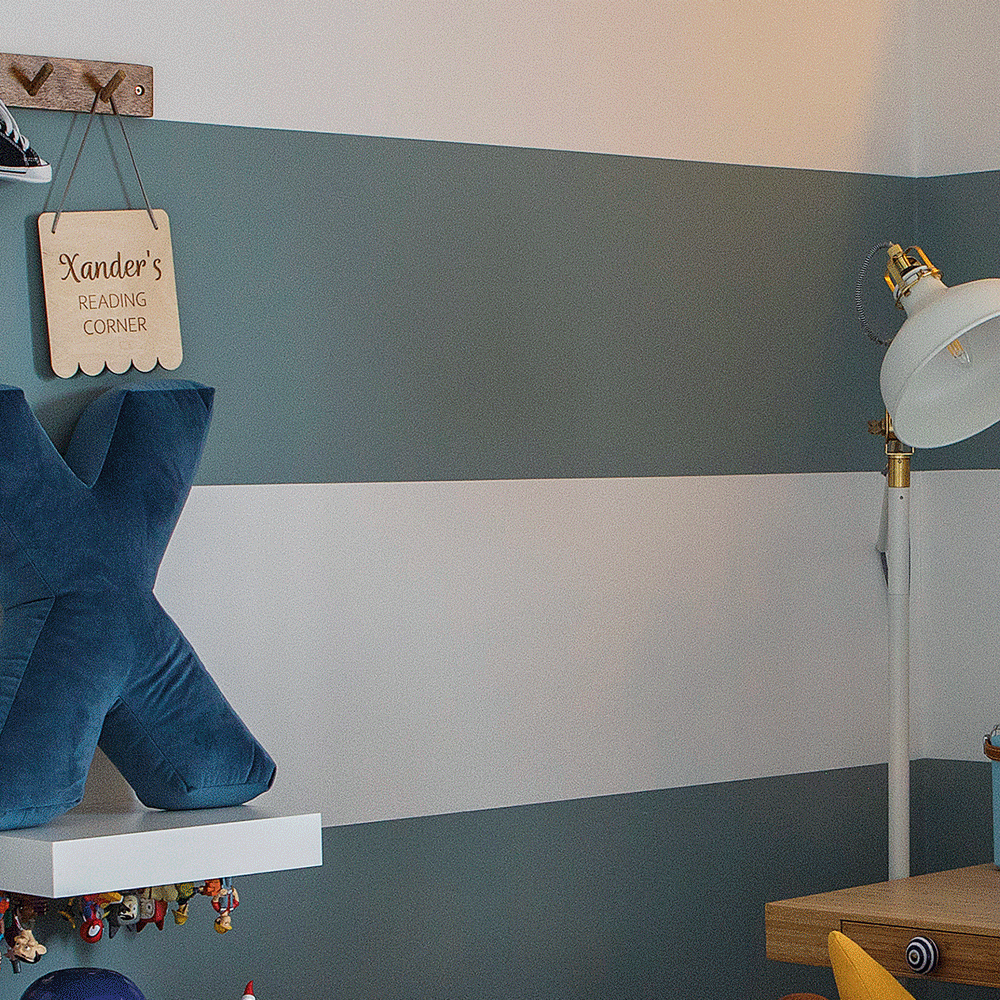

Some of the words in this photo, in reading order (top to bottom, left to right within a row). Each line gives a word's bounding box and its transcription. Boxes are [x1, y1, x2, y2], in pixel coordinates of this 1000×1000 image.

[58, 250, 163, 283] Xander's
[78, 291, 147, 310] READING
[83, 316, 148, 336] CORNER
